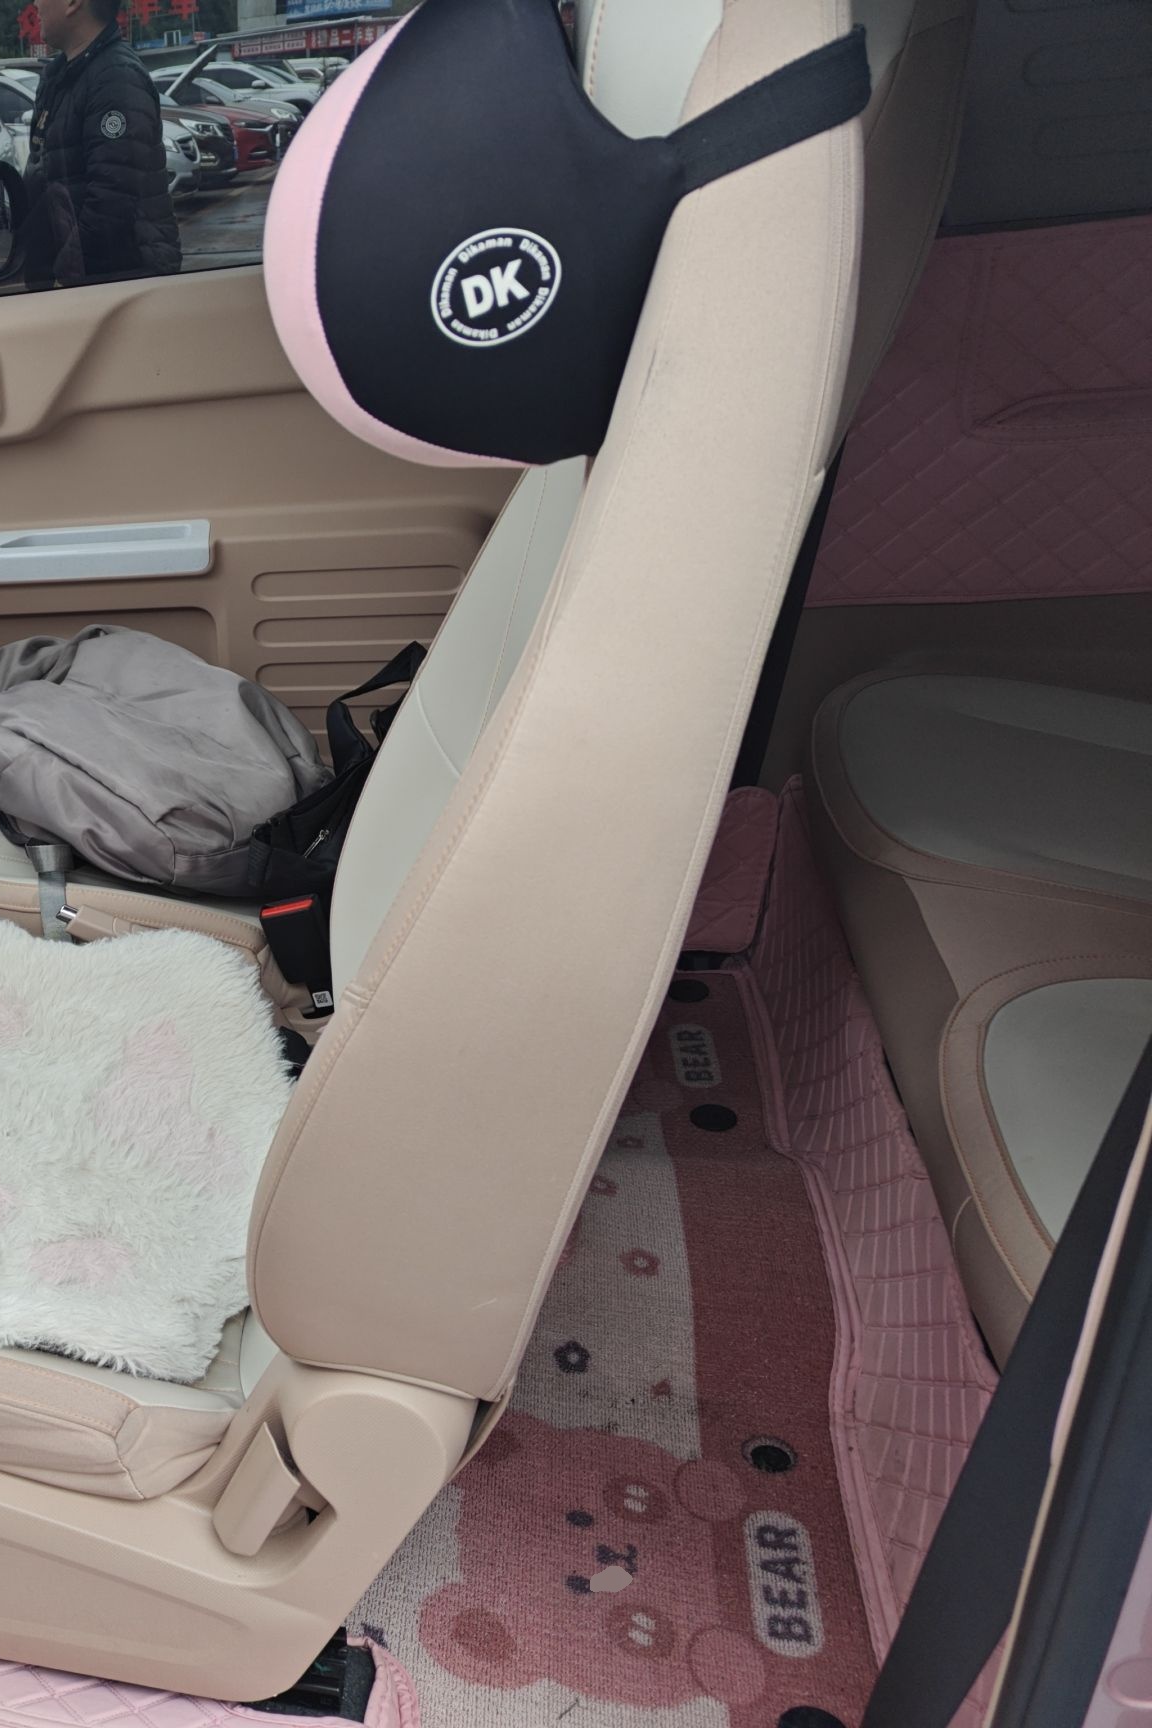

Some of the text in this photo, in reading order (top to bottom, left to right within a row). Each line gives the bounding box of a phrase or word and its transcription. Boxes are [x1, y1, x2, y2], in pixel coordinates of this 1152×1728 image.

[461, 258, 530, 318] DK
[676, 1029, 715, 1082] BEAR
[757, 1524, 815, 1646] BEAR
